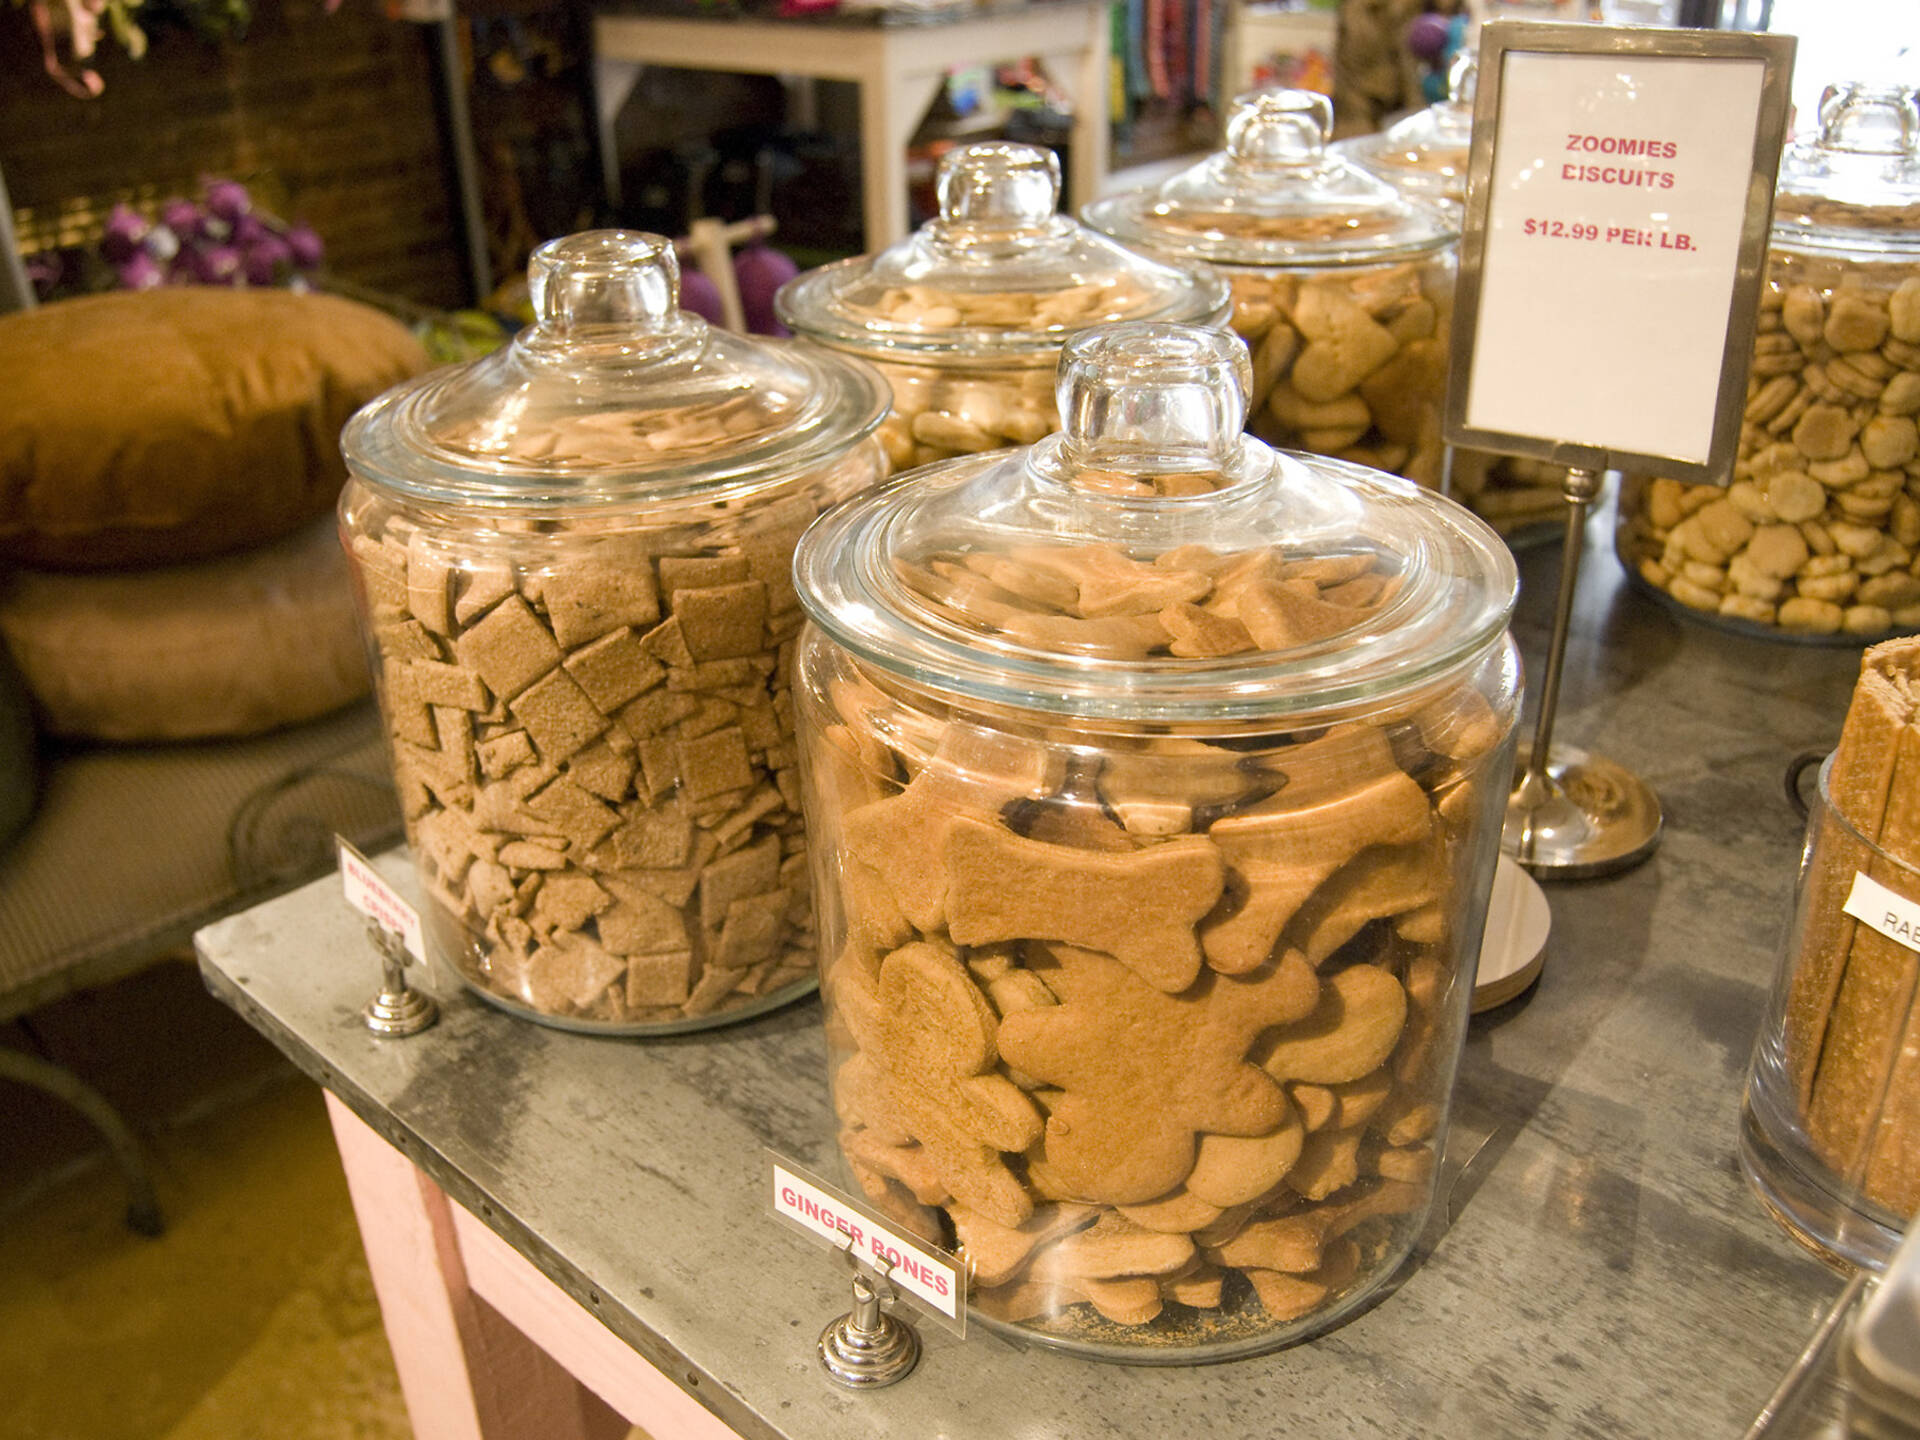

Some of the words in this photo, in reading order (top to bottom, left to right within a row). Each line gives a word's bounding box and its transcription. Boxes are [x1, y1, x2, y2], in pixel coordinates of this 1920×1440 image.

[1565, 134, 1677, 159] ZOOMIES
[1561, 164, 1675, 189] BISCUITS
[1524, 218, 1599, 241] $12.99
[1606, 227, 1652, 247] PER
[1660, 232, 1697, 251] LB.
[781, 1186, 864, 1248] GINGER
[871, 1235, 949, 1297] BONES
